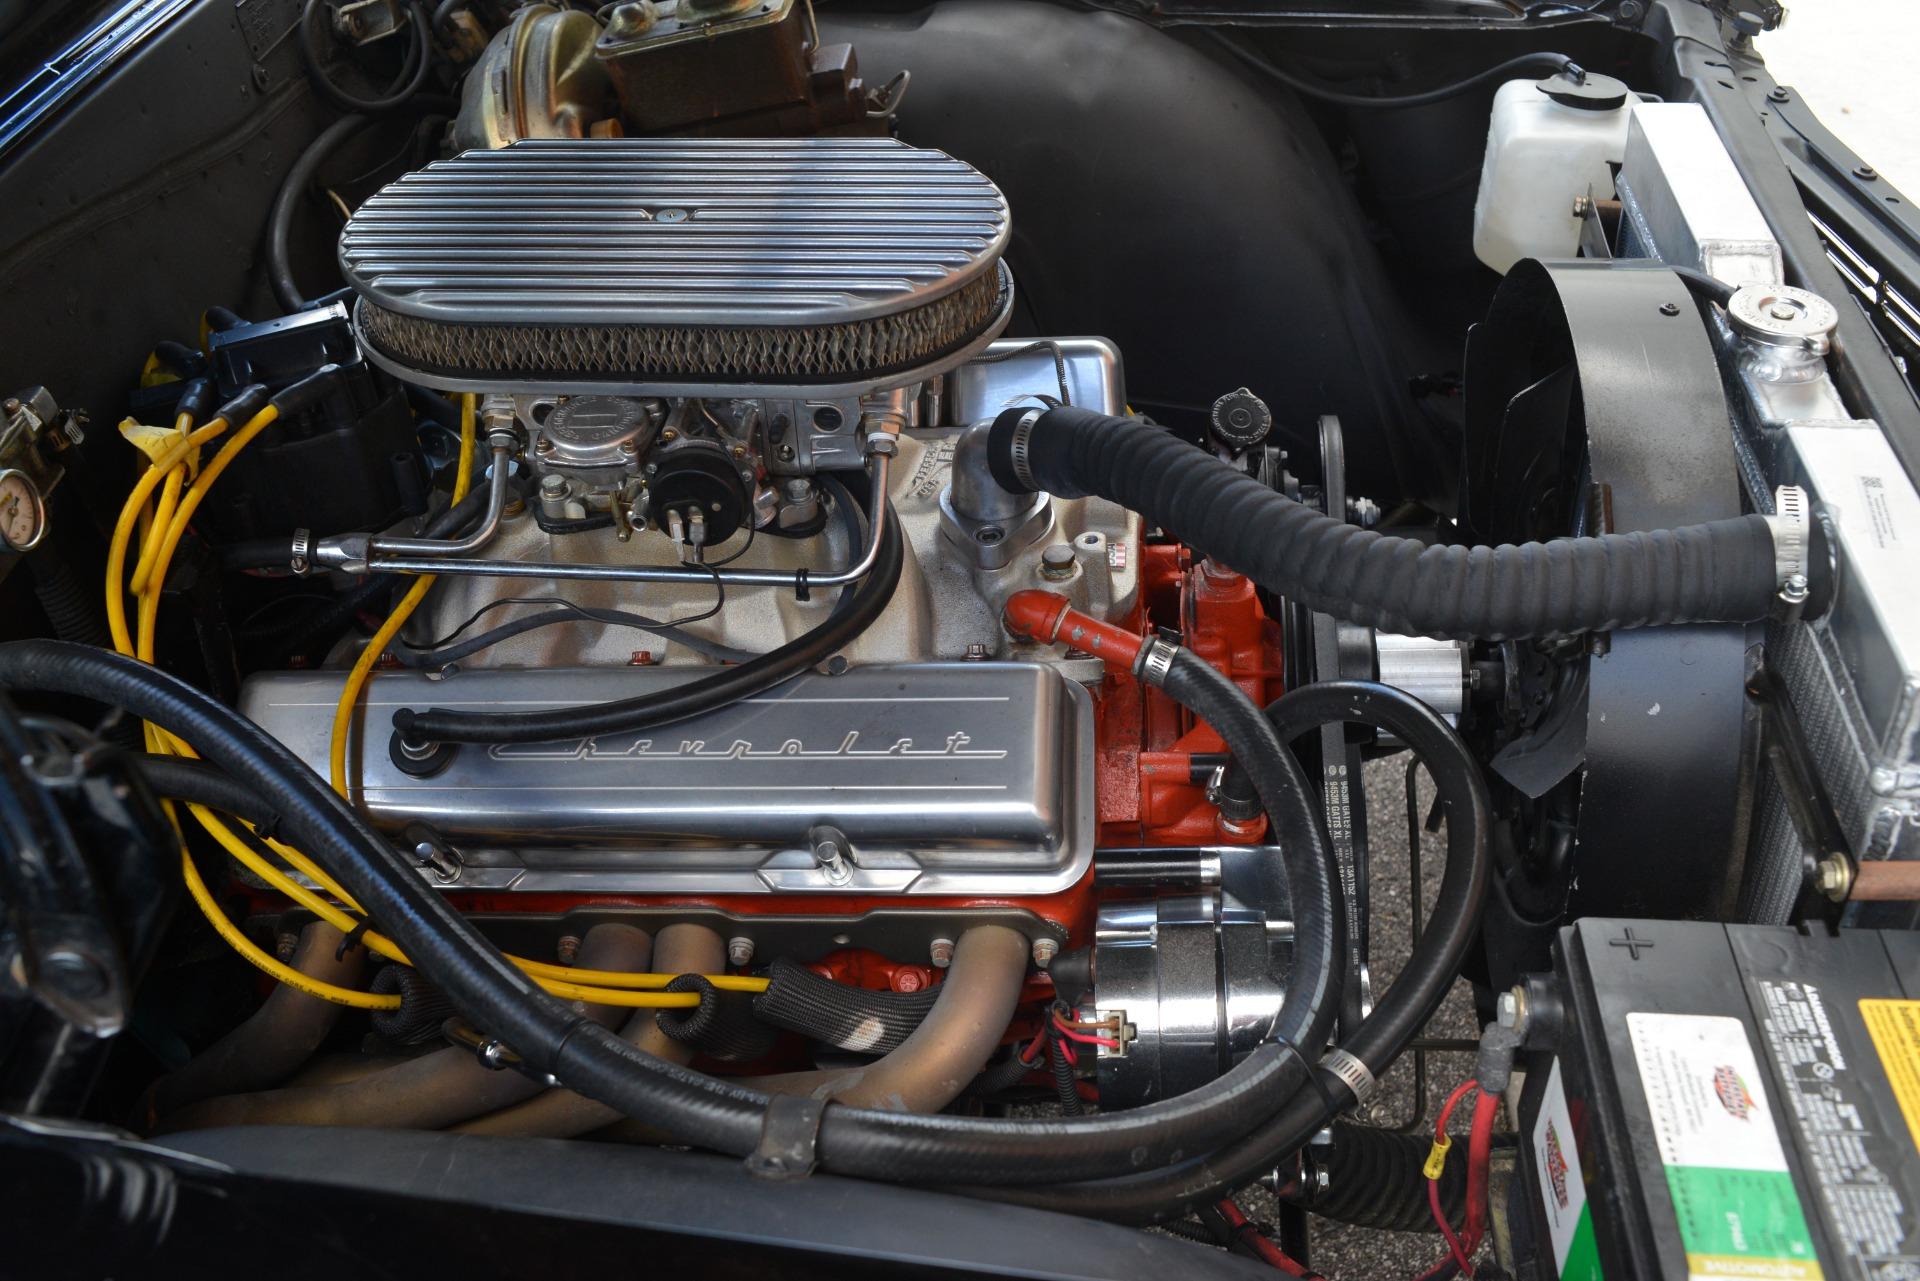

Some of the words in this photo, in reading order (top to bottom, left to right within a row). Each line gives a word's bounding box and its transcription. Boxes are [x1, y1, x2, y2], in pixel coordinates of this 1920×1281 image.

[1329, 781, 1340, 805] 9453M
[1331, 805, 1342, 829] GATES
[1343, 805, 1352, 829] GATES
[1333, 830, 1343, 840] XL
